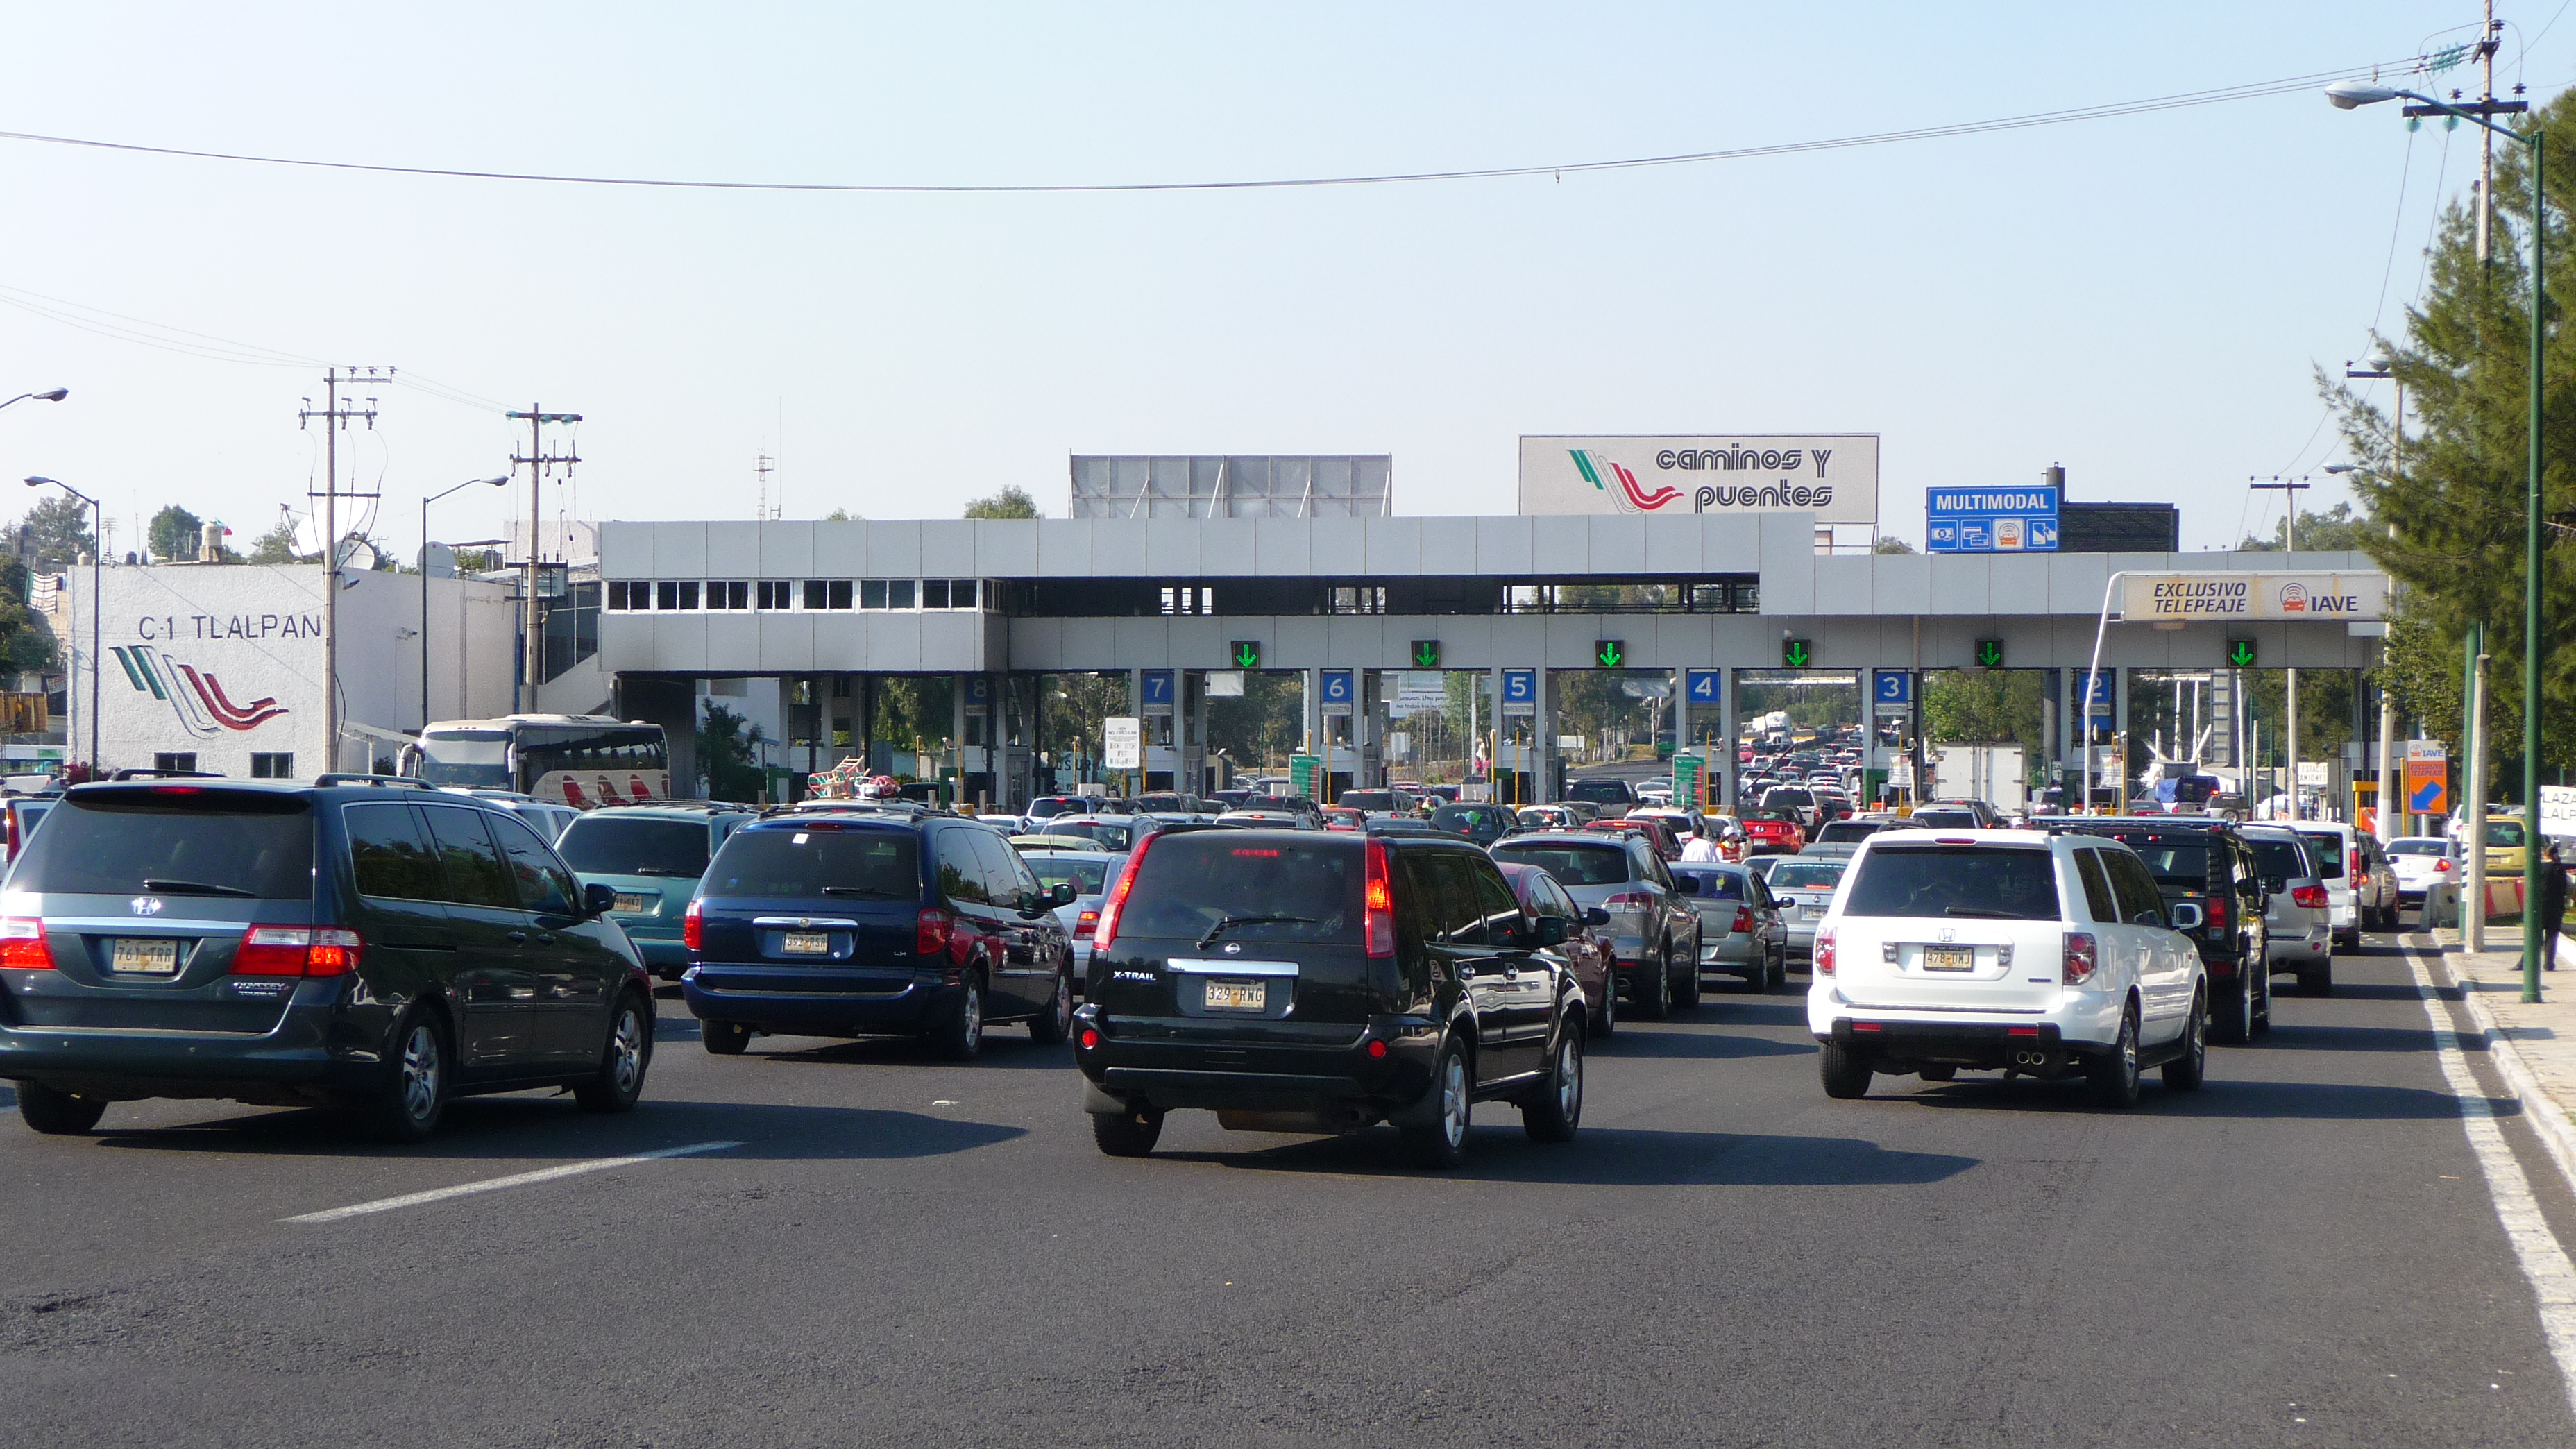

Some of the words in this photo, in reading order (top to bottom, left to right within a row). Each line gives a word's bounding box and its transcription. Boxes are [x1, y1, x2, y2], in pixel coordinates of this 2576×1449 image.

[1656, 443, 1802, 471] caminos
[1695, 479, 1833, 514] puentes
[1936, 494, 2049, 510] MULTIMODAL
[2153, 582, 2247, 597] EXCLUSIVO
[2155, 598, 2247, 613] TELEPEAJE
[2311, 595, 2359, 611] IAVE
[191, 615, 321, 639] TLALPAN
[1151, 678, 1164, 697] 7
[1329, 678, 1344, 697] 6
[1511, 677, 1526, 697] 5
[1695, 677, 1712, 697] 4
[1883, 677, 1899, 697] 3
[2086, 677, 2102, 697] 2
[2543, 791, 2576, 804] LAZA
[1113, 971, 1157, 981] X-TRAIL
